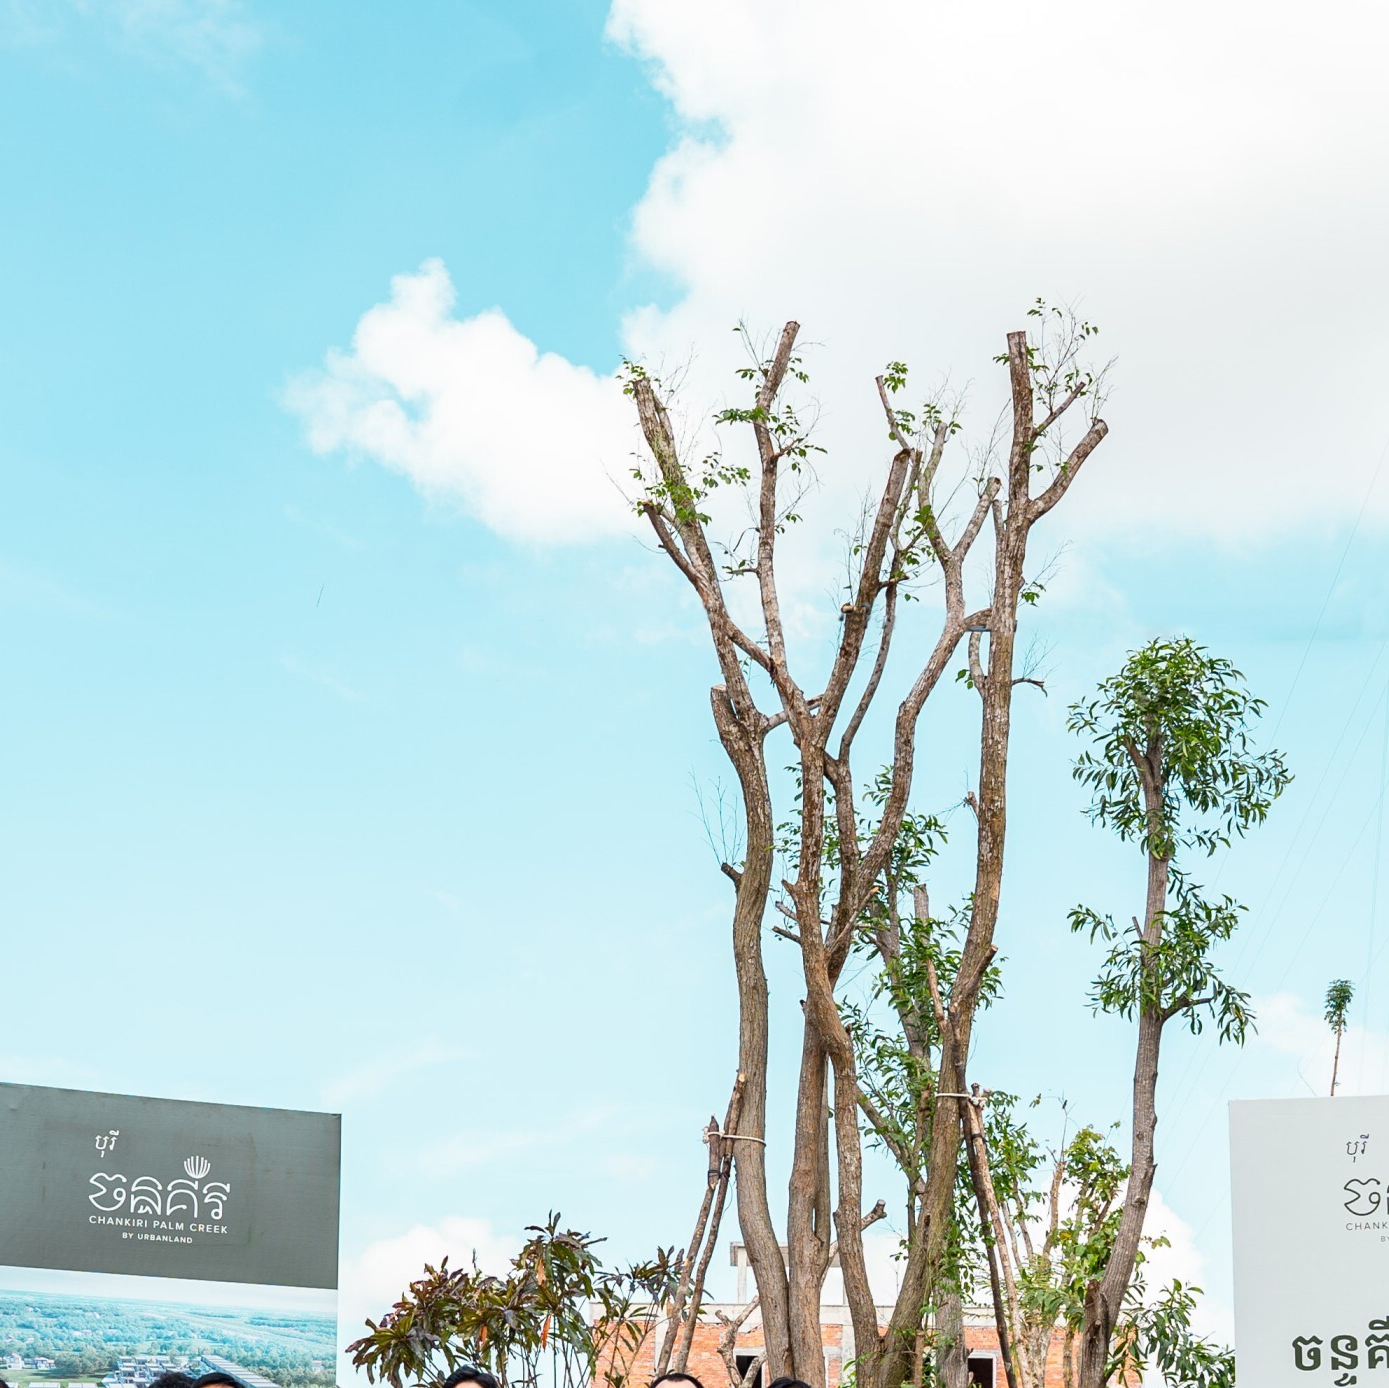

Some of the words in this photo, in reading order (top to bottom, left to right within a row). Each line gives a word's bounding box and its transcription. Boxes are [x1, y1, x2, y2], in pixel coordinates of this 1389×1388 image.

[95, 1130, 119, 1158] បុរី
[1346, 1134, 1369, 1163] បុរី
[89, 1215, 148, 1228] CHANKIRI
[153, 1220, 184, 1231] PALM
[190, 1223, 228, 1234] CREEK
[137, 1233, 193, 1244] URBANLAND
